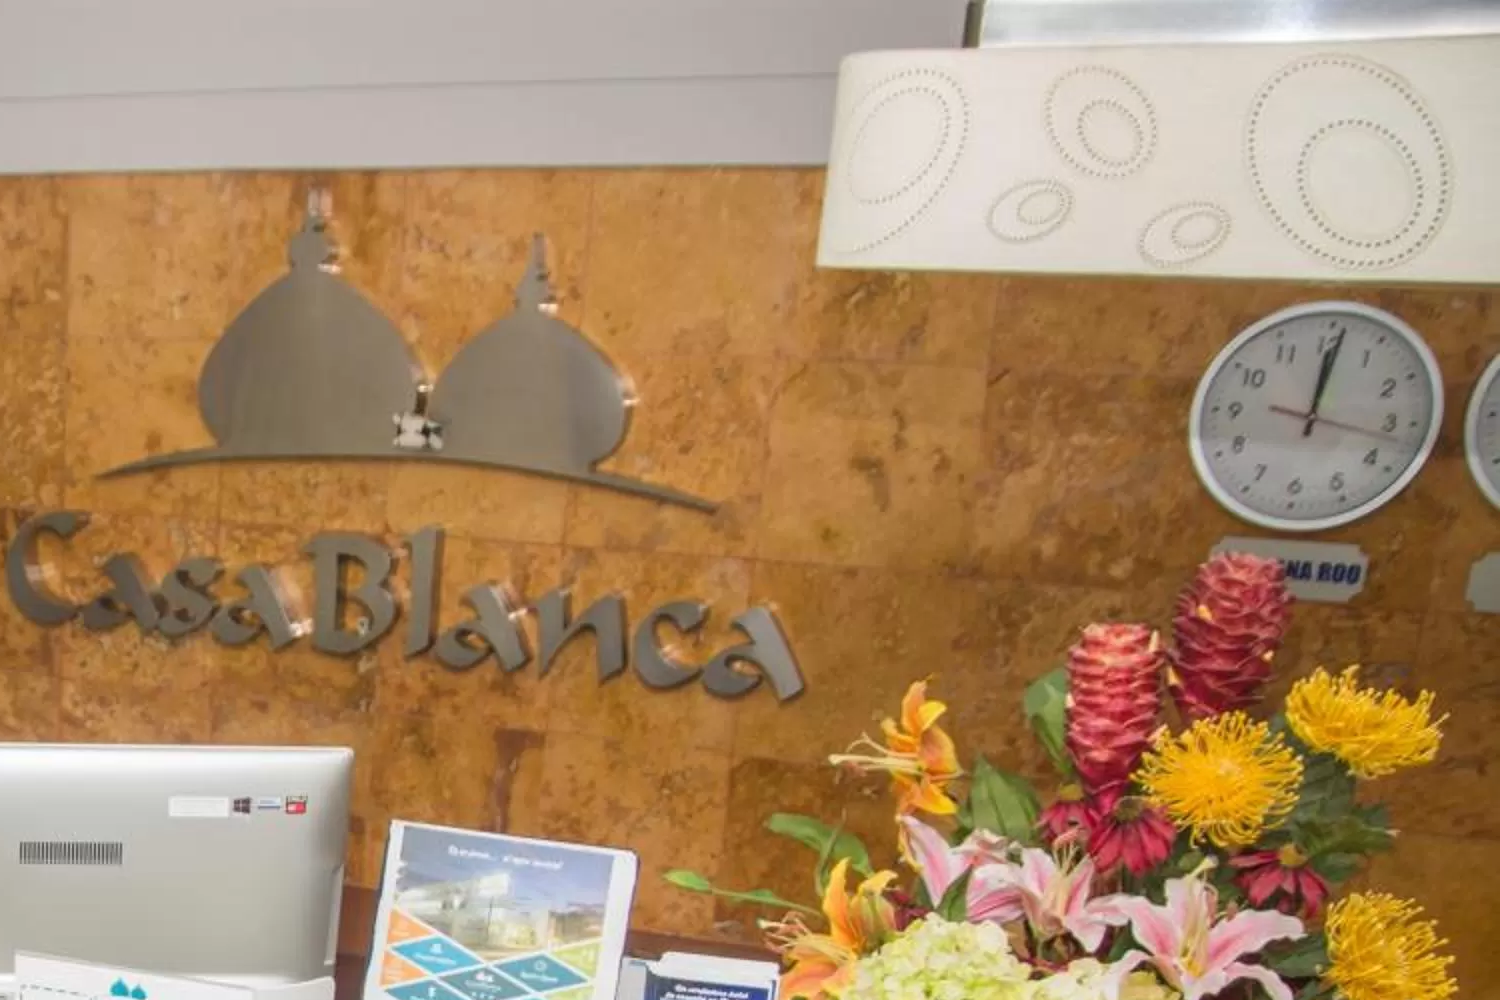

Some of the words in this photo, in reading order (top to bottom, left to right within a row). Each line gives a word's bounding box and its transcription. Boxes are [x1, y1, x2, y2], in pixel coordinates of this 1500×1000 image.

[1276, 344, 1297, 364] 11
[1361, 350, 1371, 368] 1
[1242, 367, 1266, 388] 10
[1379, 377, 1397, 398] 2
[1228, 401, 1243, 419] 9
[1381, 412, 1397, 433] 3
[1231, 435, 1246, 453] 8
[1362, 447, 1379, 466] 4
[1254, 462, 1268, 481] 7
[1287, 476, 1303, 495] 6
[1329, 471, 1344, 492] 5
[1283, 559, 1313, 580] NA
[1316, 561, 1362, 585] ROO
